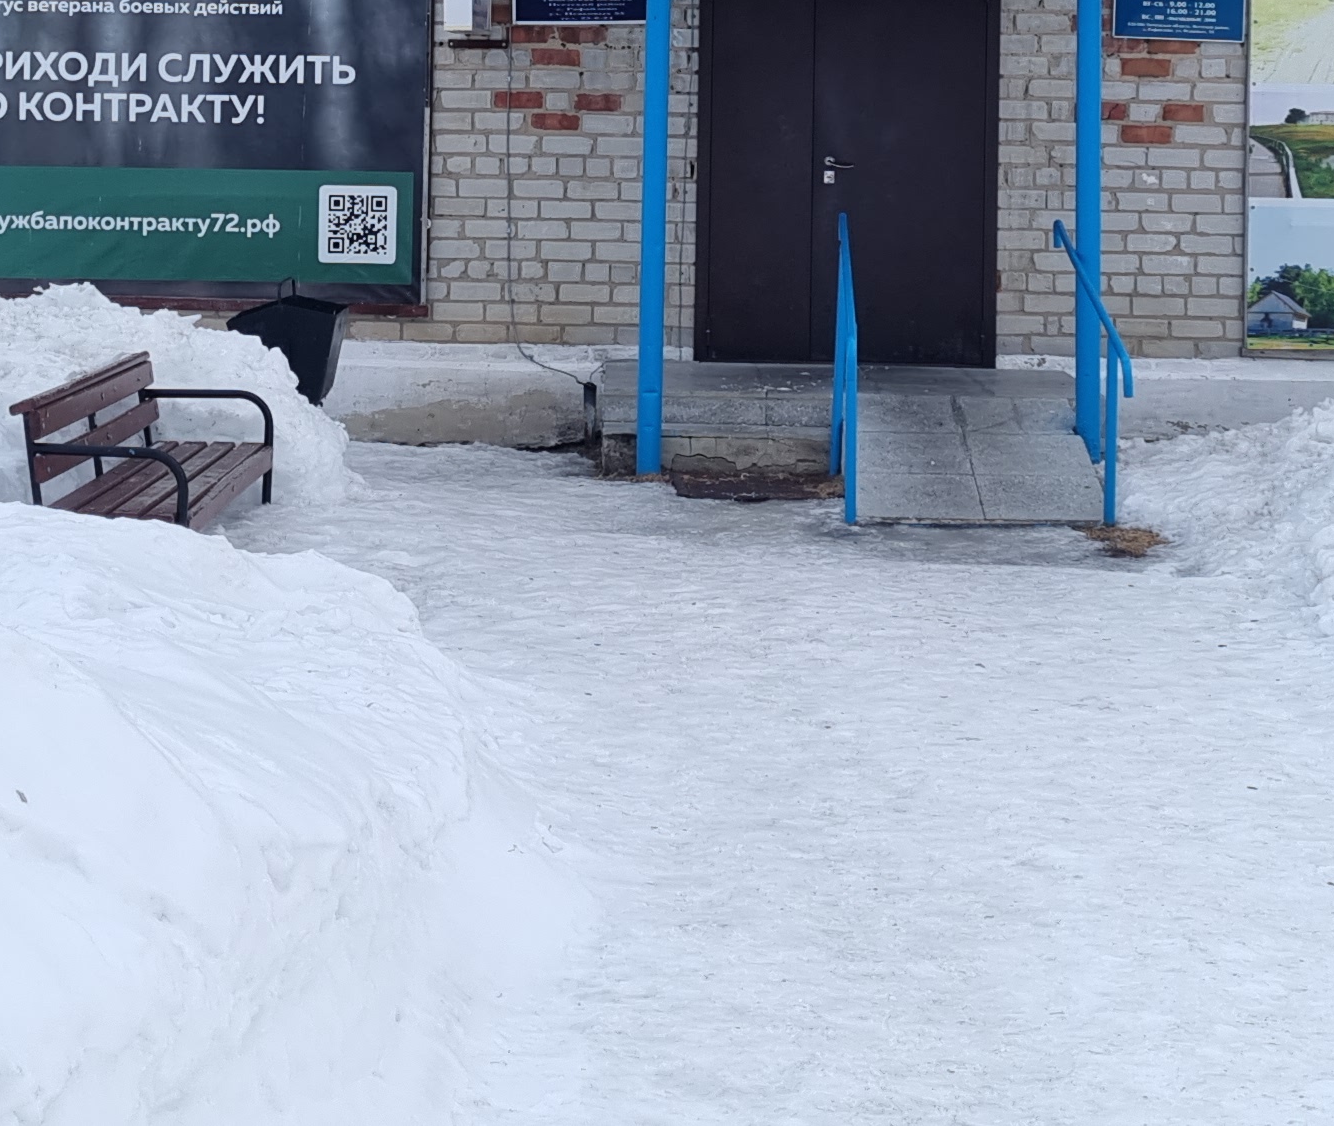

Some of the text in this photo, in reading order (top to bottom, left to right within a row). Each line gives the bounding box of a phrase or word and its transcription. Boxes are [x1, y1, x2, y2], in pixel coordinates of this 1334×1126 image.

[27, 0, 115, 17] ветерана
[158, 53, 357, 86] СЛУЖИТЬ
[19, 91, 266, 126] КОНТРАКТУ!
